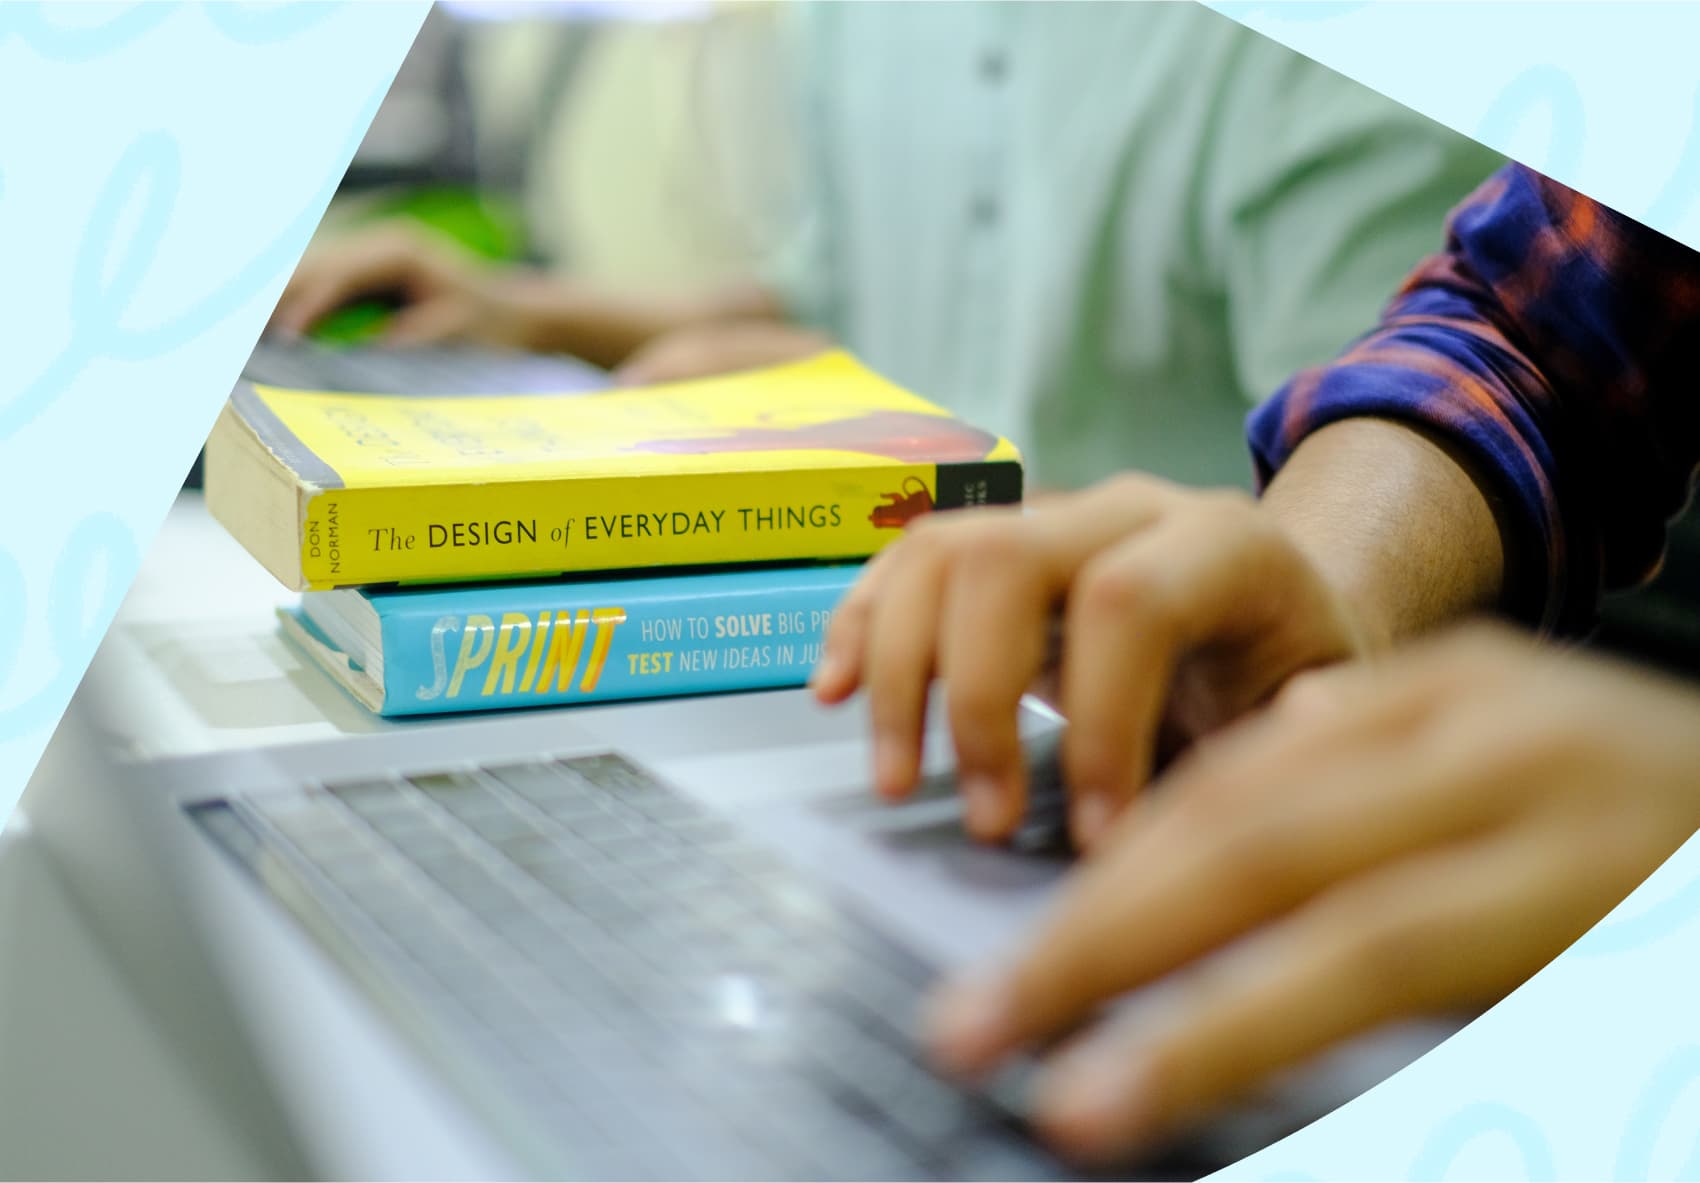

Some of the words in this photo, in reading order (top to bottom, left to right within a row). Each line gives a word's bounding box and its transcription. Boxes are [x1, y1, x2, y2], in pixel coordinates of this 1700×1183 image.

[310, 520, 321, 557] DON
[328, 502, 339, 574] NORMAN
[368, 527, 415, 552] The
[429, 519, 537, 548] DESIGN
[551, 518, 575, 549] of
[585, 510, 726, 540] EVERYDAY
[738, 504, 842, 531] THINGS
[641, 618, 682, 642] HOW
[688, 616, 709, 640] TO
[714, 613, 773, 638] SOLVE
[778, 611, 805, 634] BIG
[811, 610, 833, 632] PR
[416, 607, 627, 700] SPRINT
[627, 652, 674, 675] TEST
[680, 650, 718, 672] NEW
[723, 646, 771, 670] IDEAS
[777, 645, 794, 666] IN
